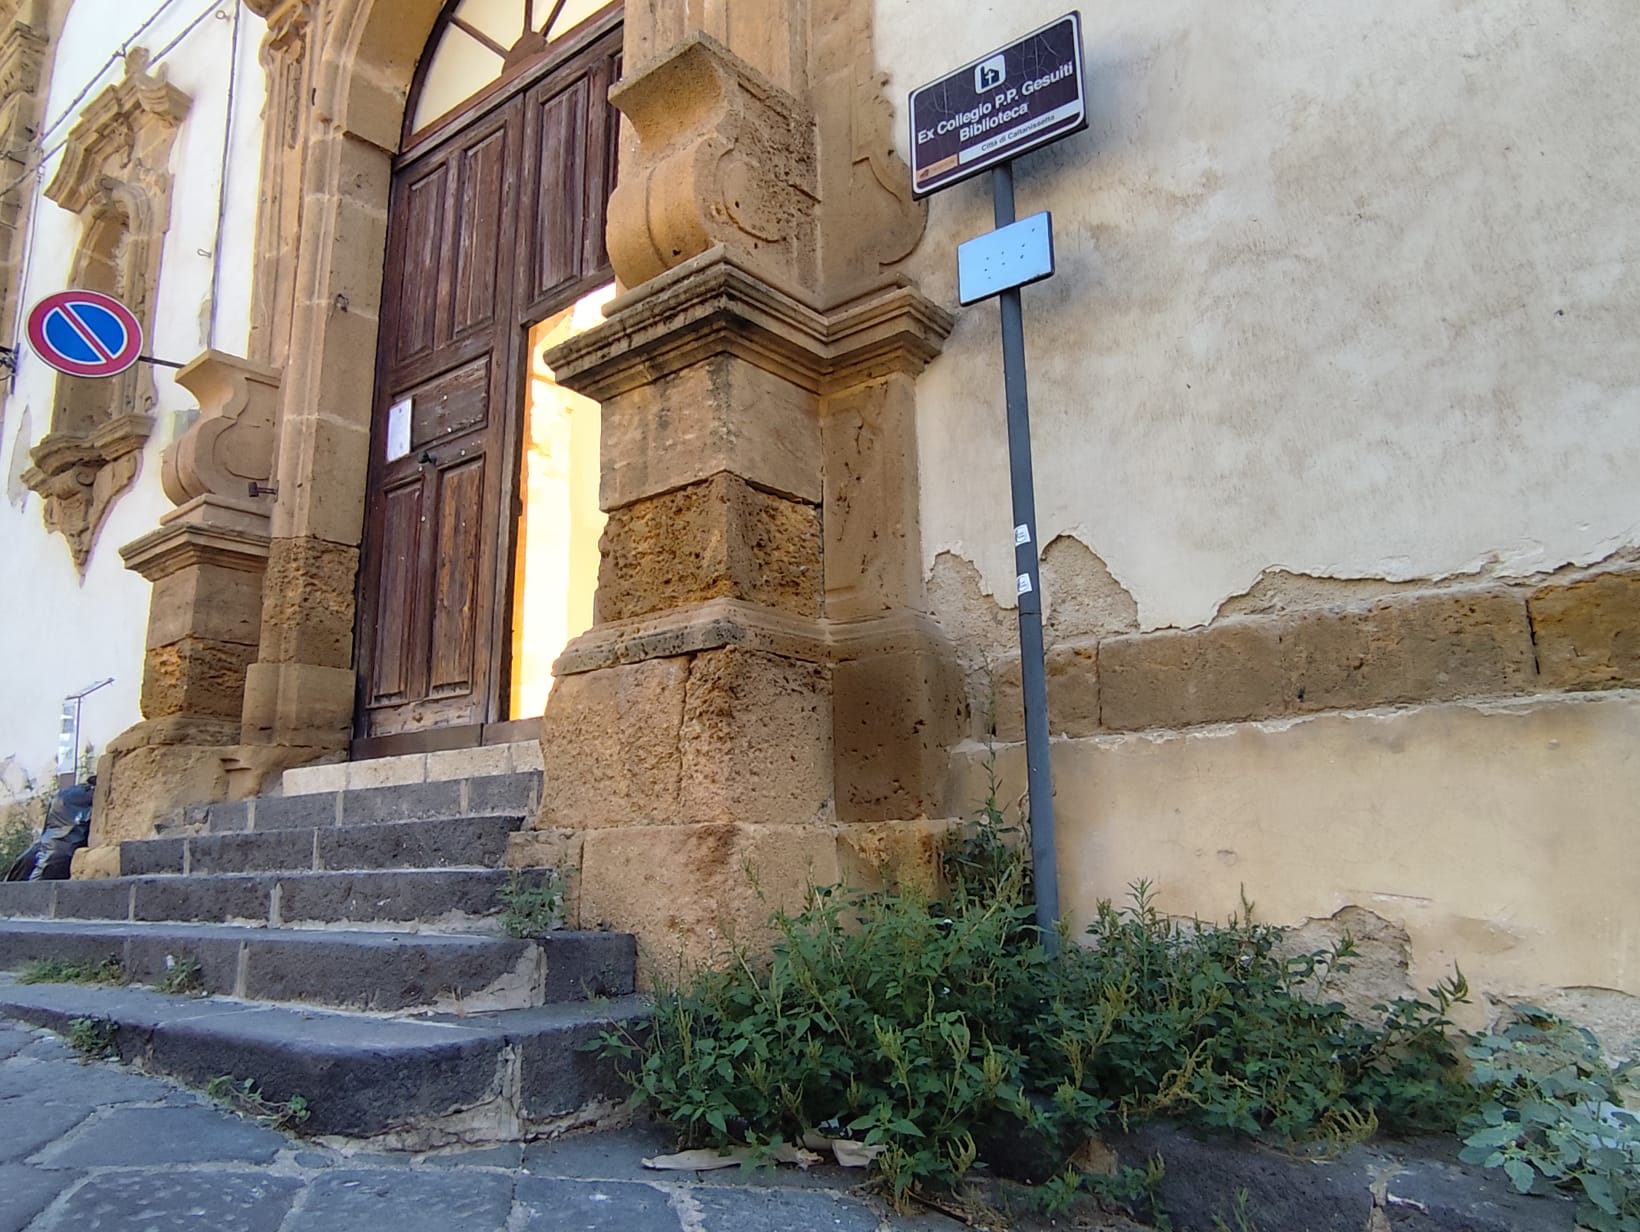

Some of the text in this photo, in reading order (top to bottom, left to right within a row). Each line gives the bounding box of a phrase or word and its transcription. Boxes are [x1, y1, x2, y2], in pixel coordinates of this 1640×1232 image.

[918, 61, 1073, 144] Ex Collegio P.P. Gesuiti
[959, 102, 1029, 142] Biblioteca
[999, 135, 1006, 143] di
[1007, 115, 1055, 140] Caltanissetta
